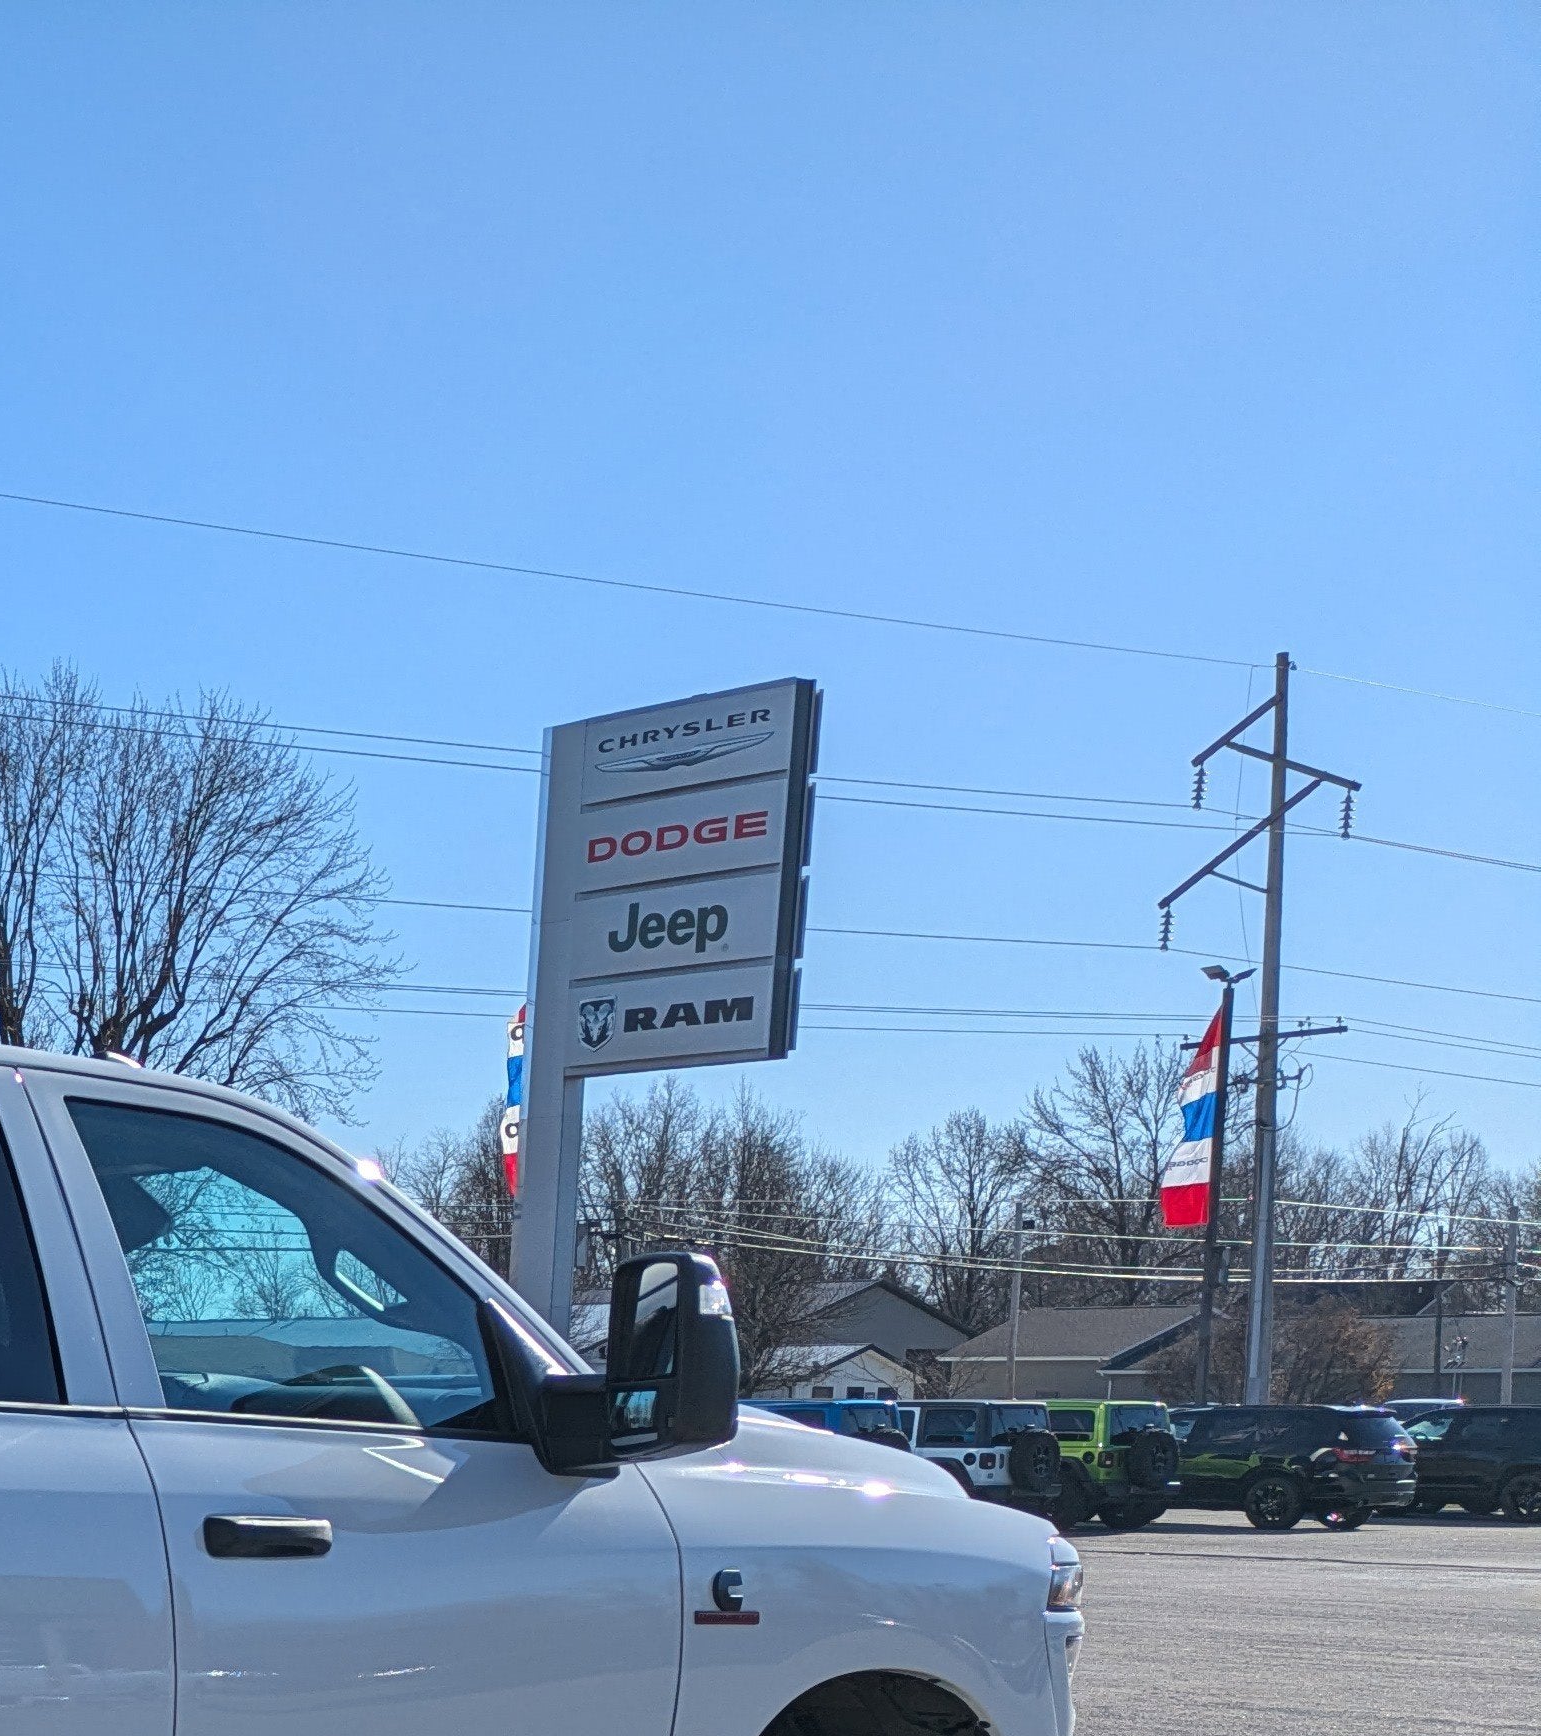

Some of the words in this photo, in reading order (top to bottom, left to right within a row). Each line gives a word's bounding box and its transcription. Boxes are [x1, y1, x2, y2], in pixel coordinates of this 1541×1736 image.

[598, 708, 771, 754] CHRYSLER
[587, 810, 769, 864] DODGE
[608, 901, 729, 954] Jeep
[623, 995, 755, 1034] RAM
